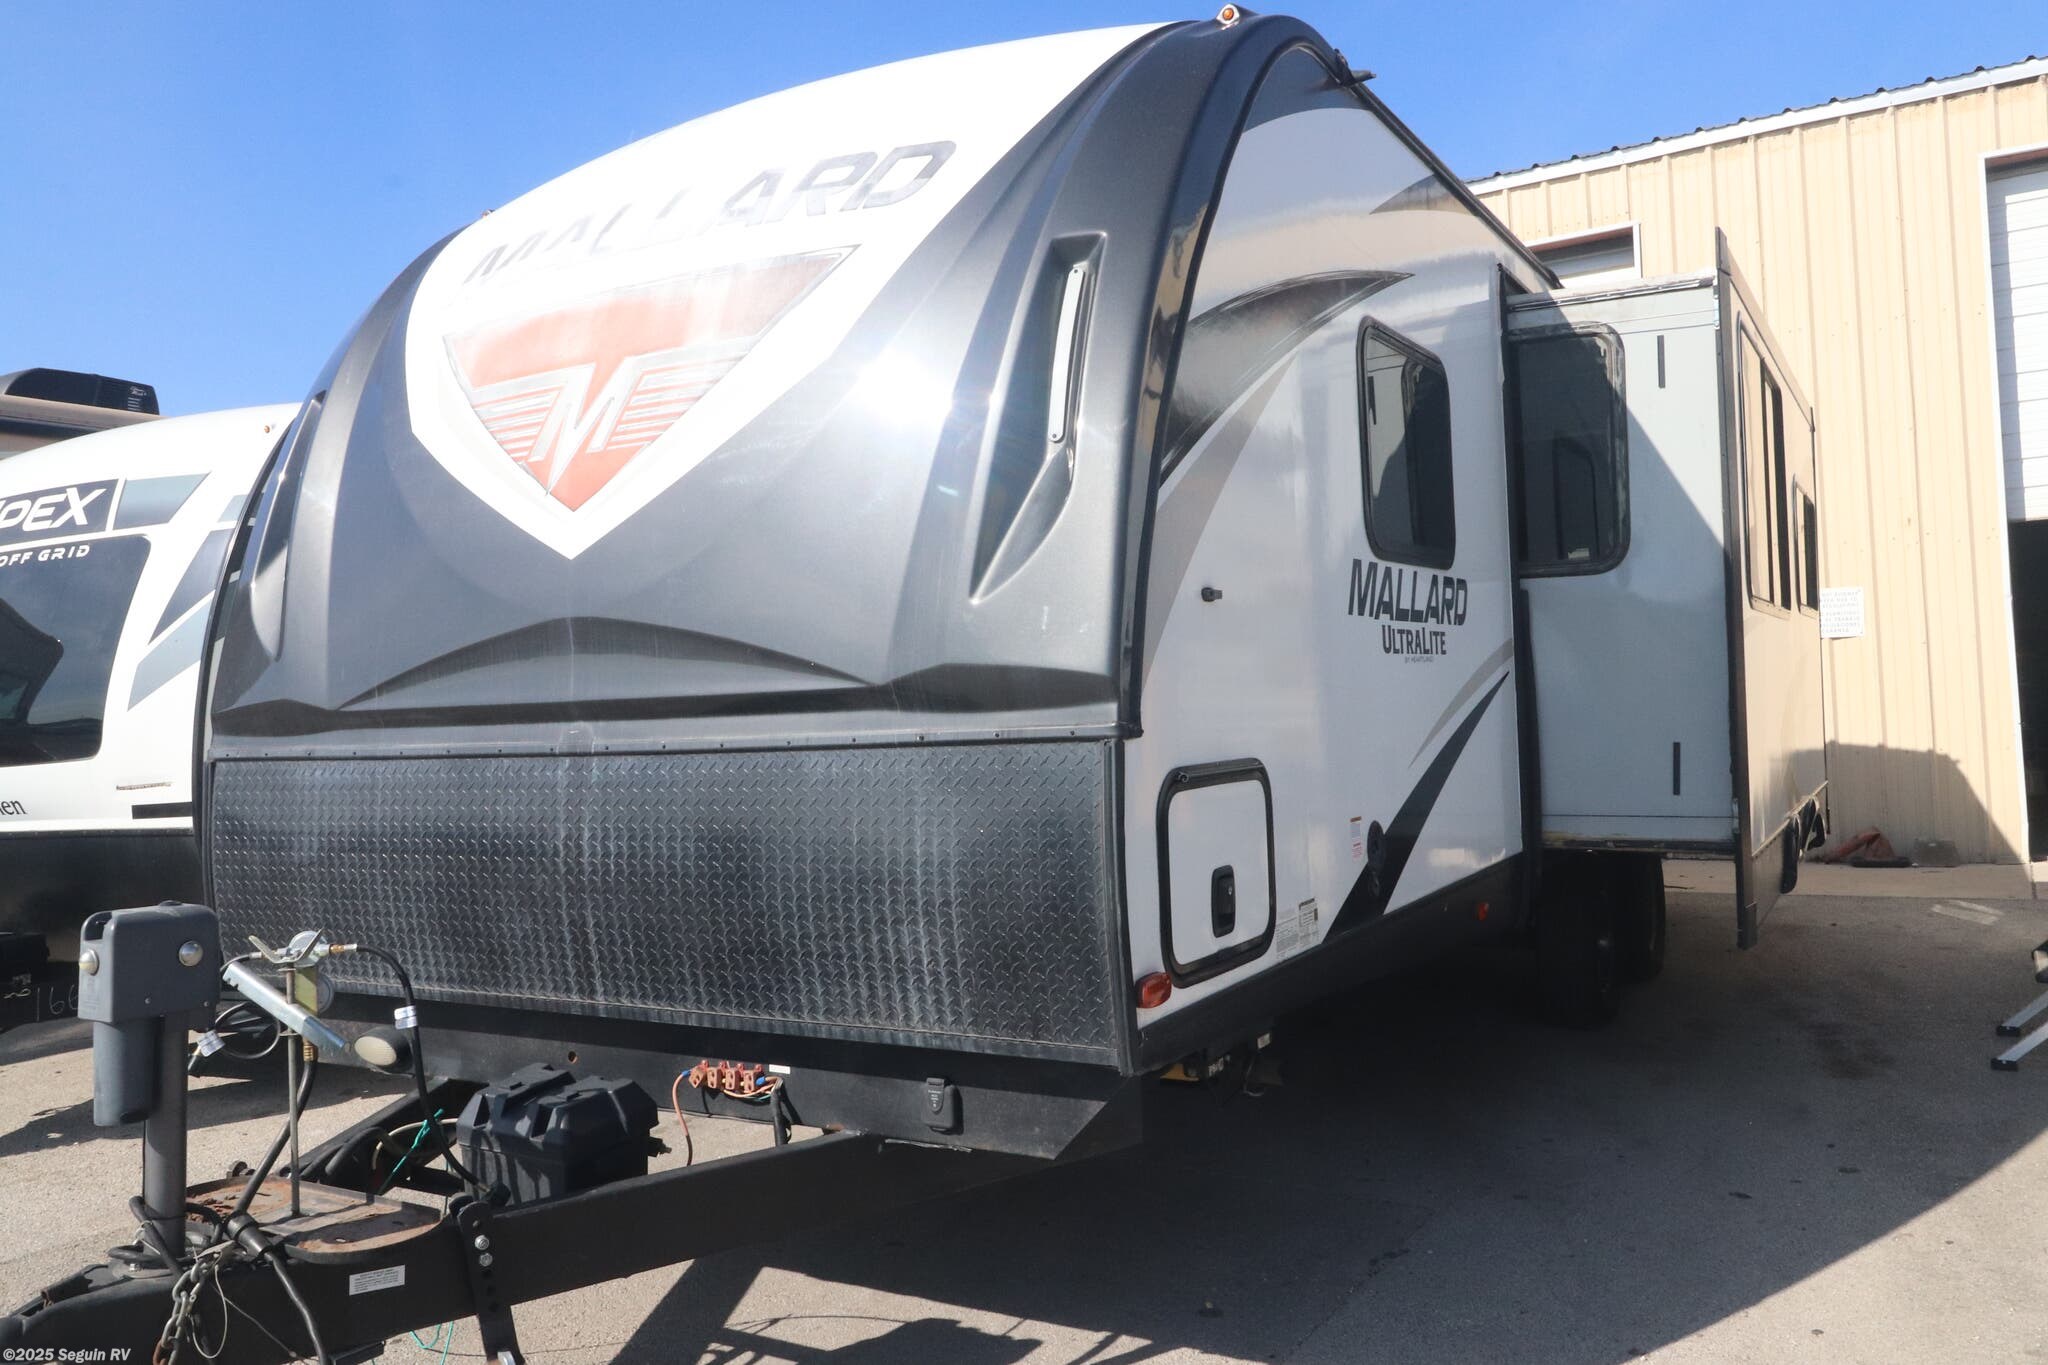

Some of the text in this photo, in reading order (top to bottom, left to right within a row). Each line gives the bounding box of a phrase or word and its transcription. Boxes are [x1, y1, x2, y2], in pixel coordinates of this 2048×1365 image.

[0, 486, 107, 531] PEX
[0, 544, 90, 567] OFF GRID
[1347, 558, 1468, 626] MALLARD
[1381, 625, 1446, 655] ULTRALITE
[0, 800, 26, 815] en
